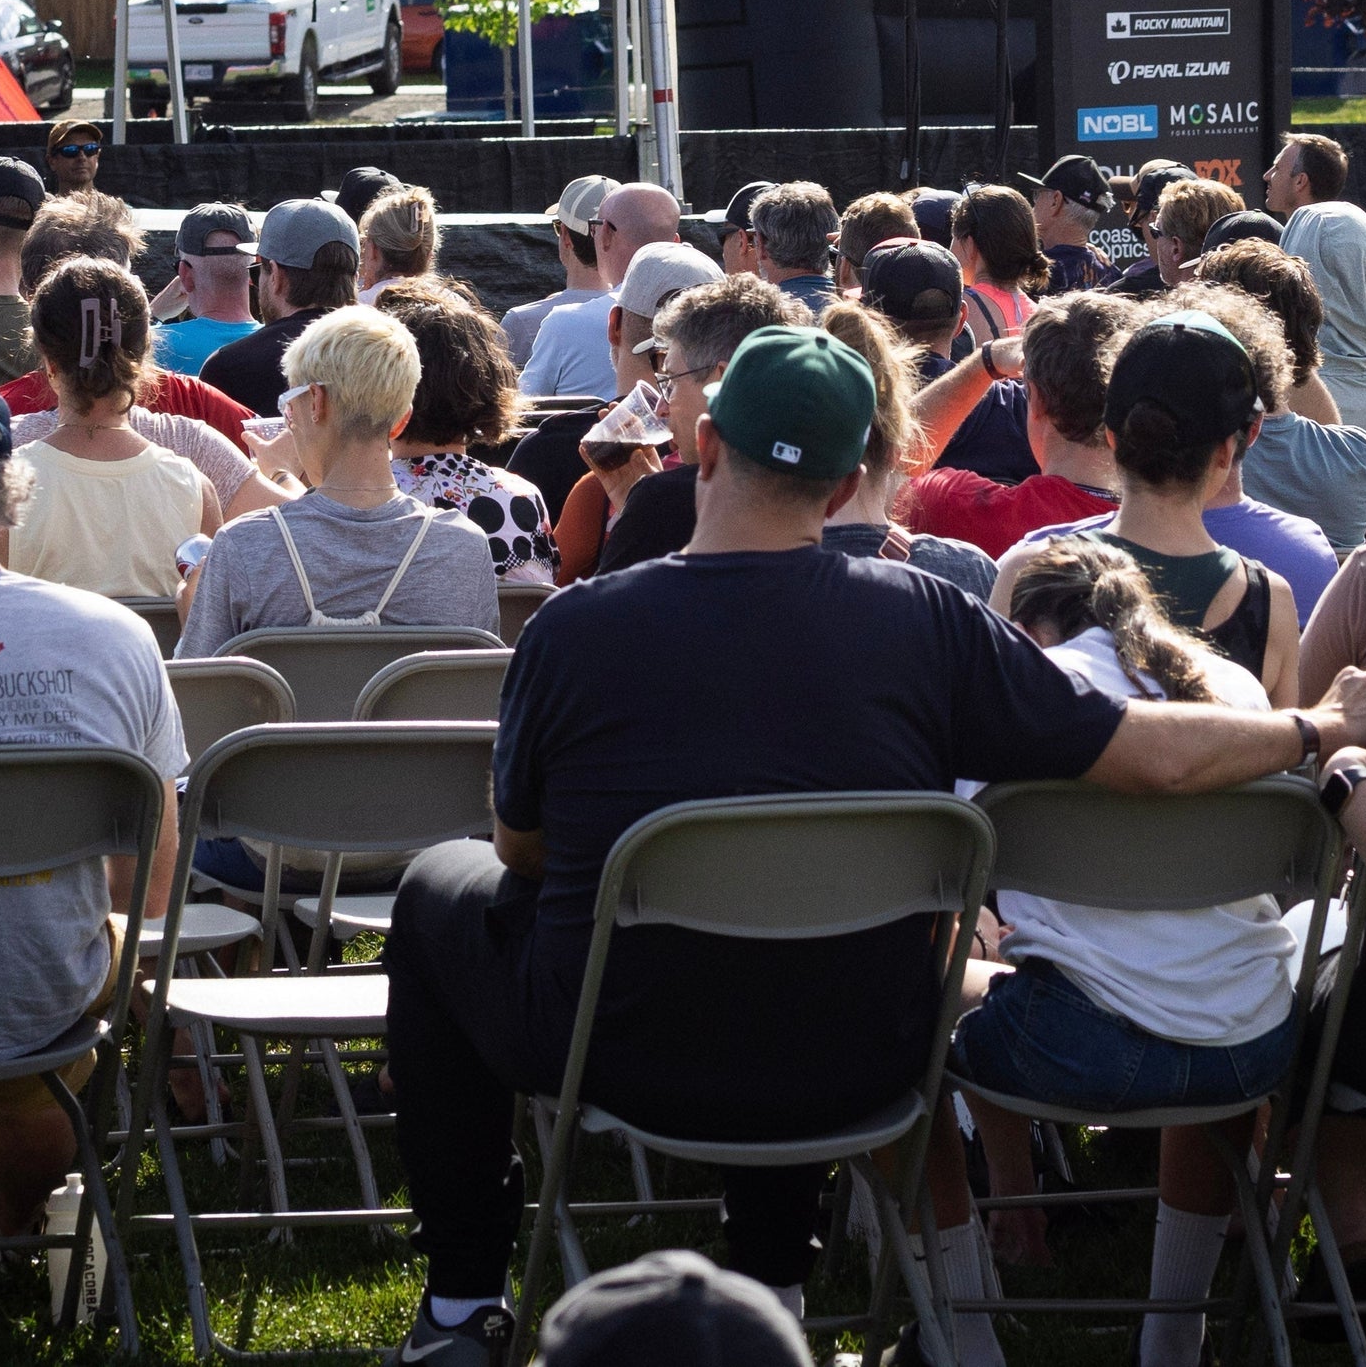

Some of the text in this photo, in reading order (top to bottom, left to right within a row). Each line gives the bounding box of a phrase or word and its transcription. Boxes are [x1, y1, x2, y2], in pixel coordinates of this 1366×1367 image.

[1134, 16, 1224, 31] ROCKY MOUNTAIN
[1132, 63, 1183, 79] PEARL
[1084, 101, 1259, 134] NOBL MOSAIC
[1204, 126, 1259, 135] MANAGEMENT
[1194, 159, 1242, 187] FOX
[13, 712, 39, 725] MY
[43, 710, 79, 724] DEER
